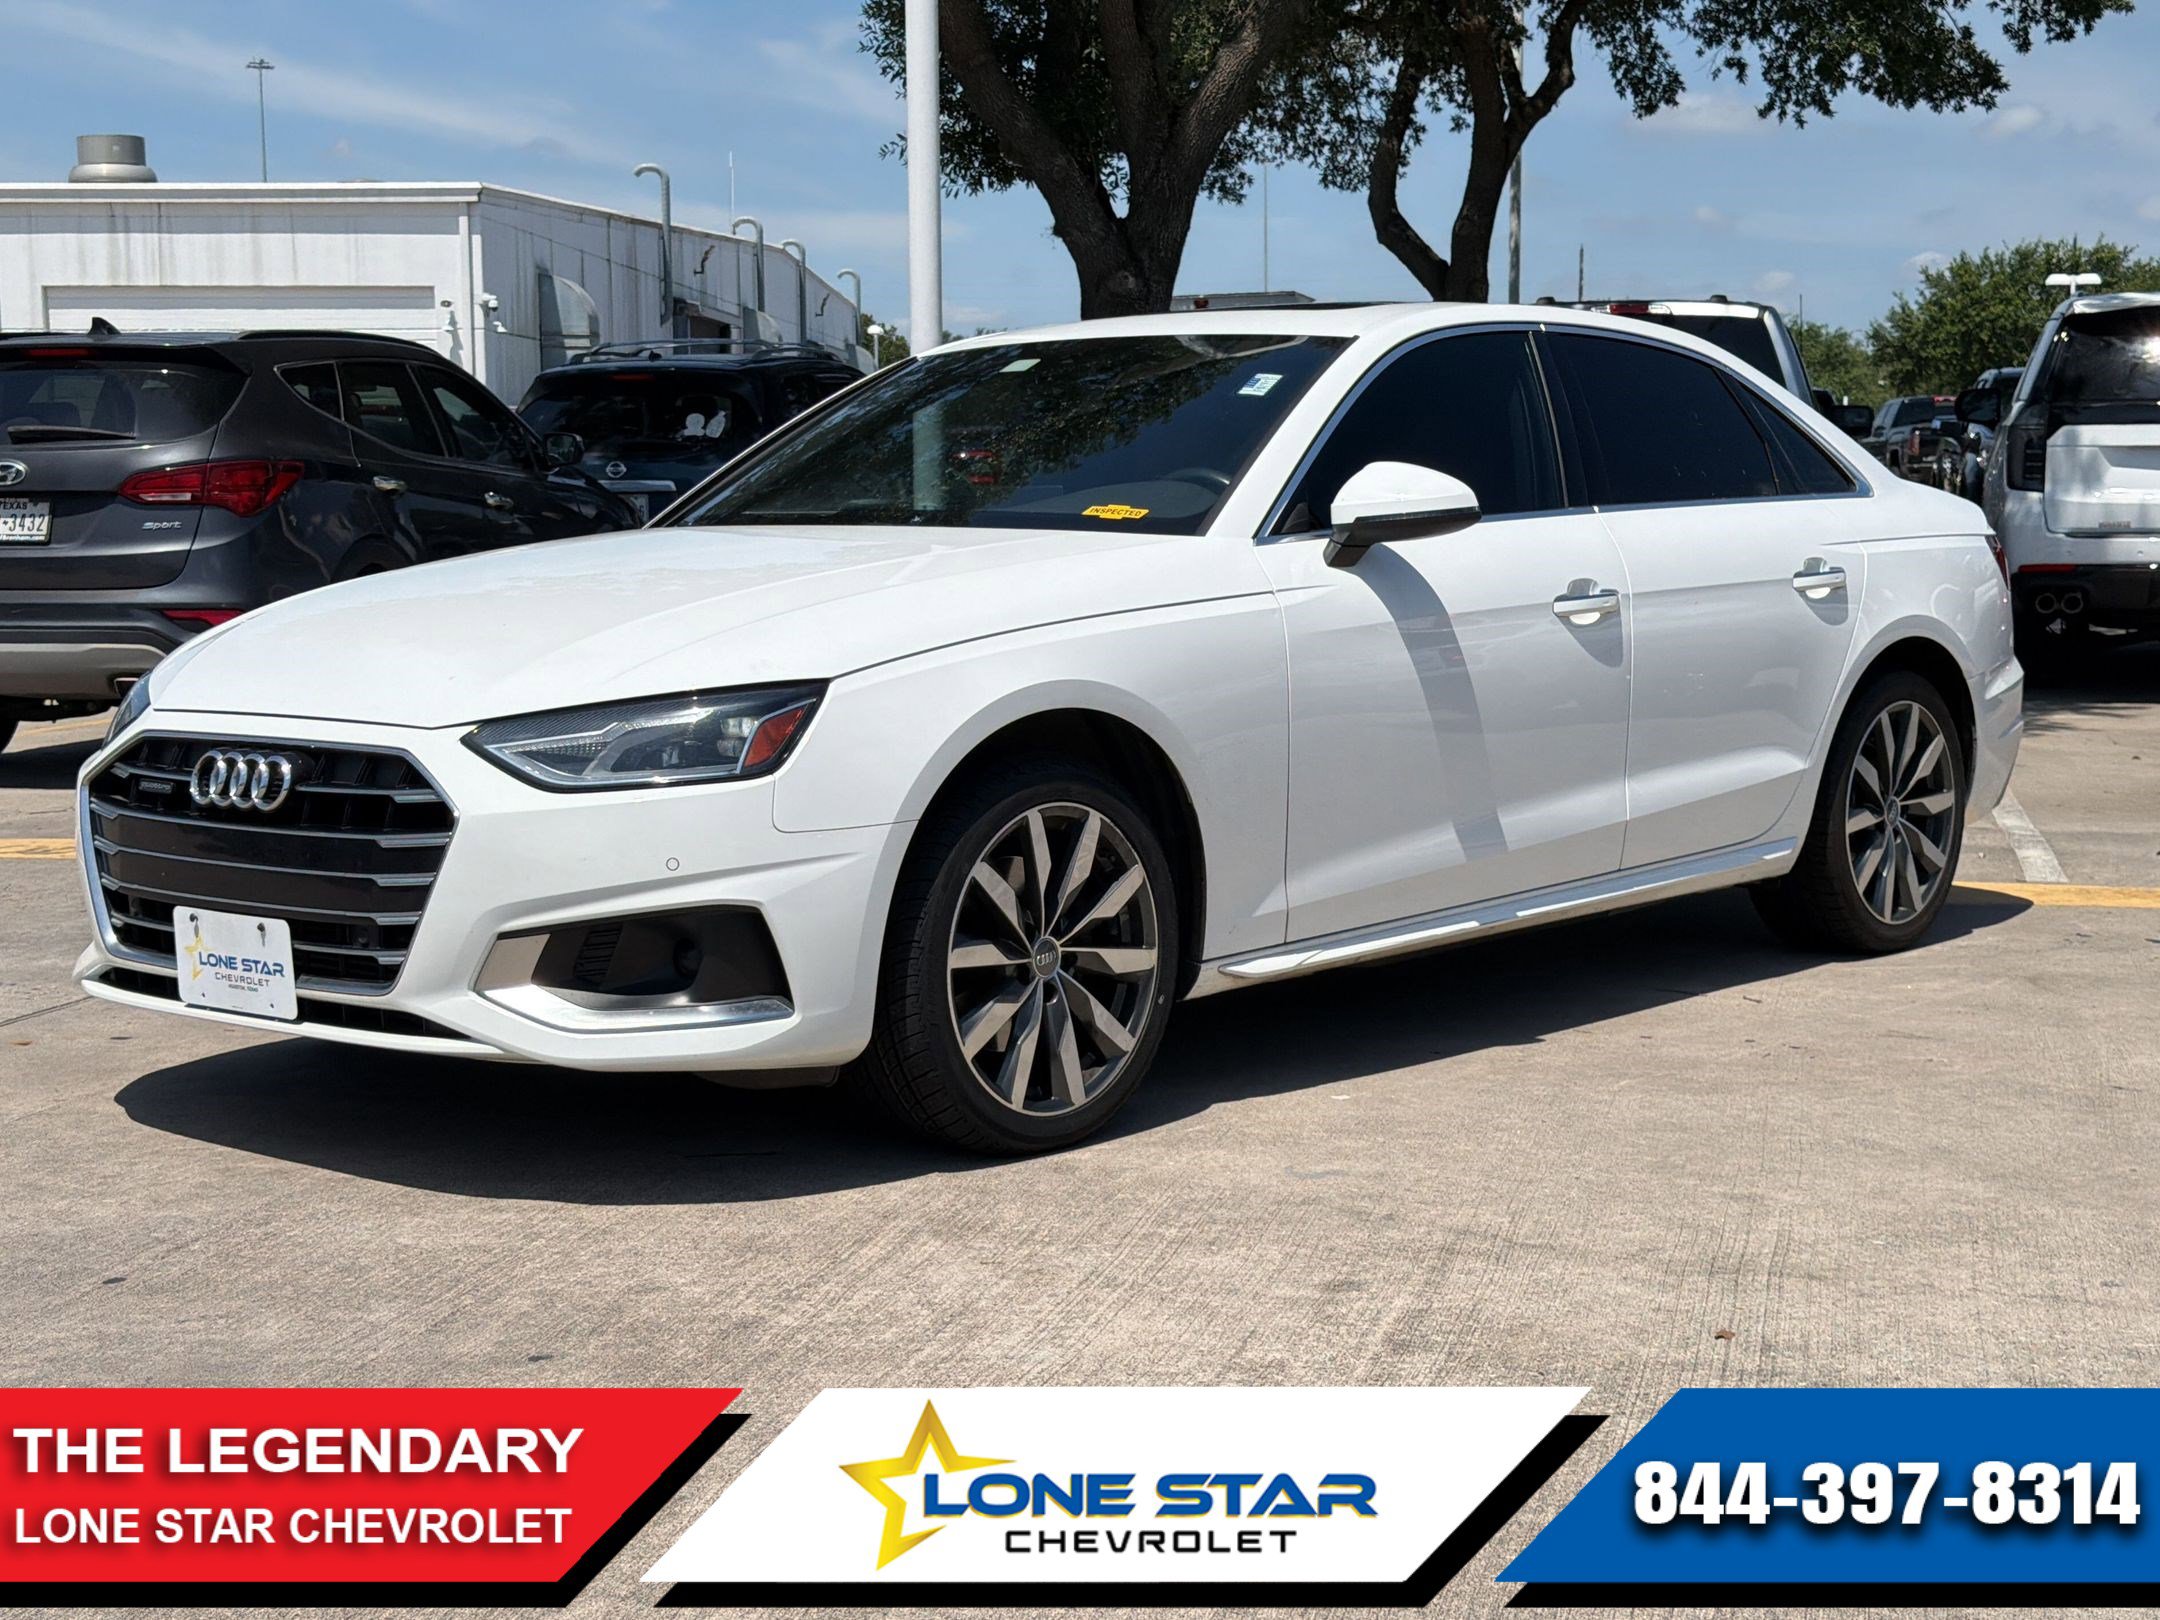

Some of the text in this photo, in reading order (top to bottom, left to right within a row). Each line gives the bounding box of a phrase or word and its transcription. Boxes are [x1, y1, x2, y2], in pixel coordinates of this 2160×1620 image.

[1090, 507, 1142, 517] INSPECTED
[199, 952, 285, 978] LONE STAR
[215, 972, 270, 987] CHEVROLET
